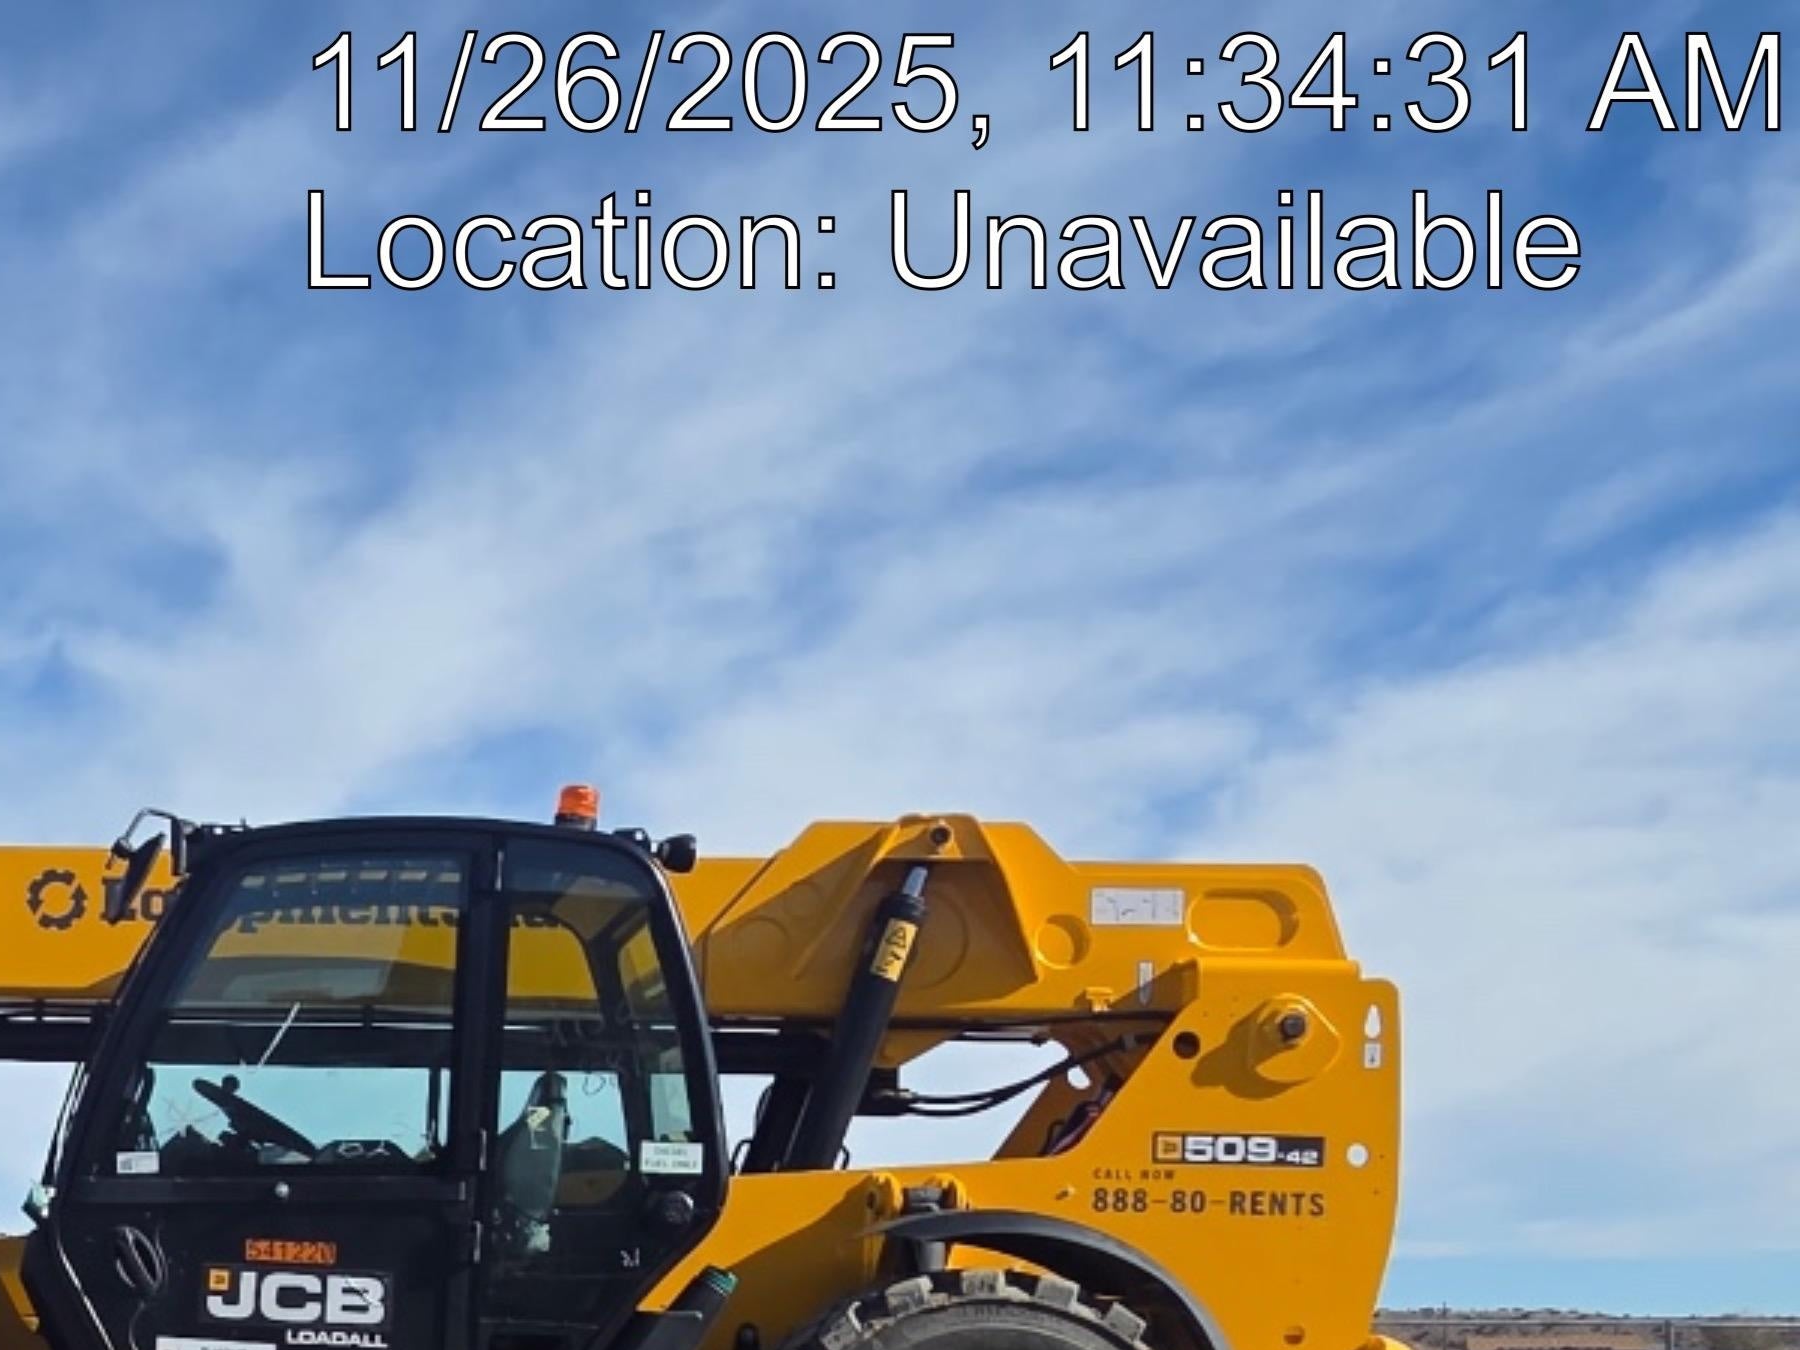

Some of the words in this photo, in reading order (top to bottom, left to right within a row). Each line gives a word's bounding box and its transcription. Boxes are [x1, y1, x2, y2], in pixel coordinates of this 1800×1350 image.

[1092, 1168, 1132, 1181] CALL
[1140, 1169, 1176, 1181] NOW
[206, 1271, 386, 1325] JCB
[286, 1328, 389, 1349] LOADALL
